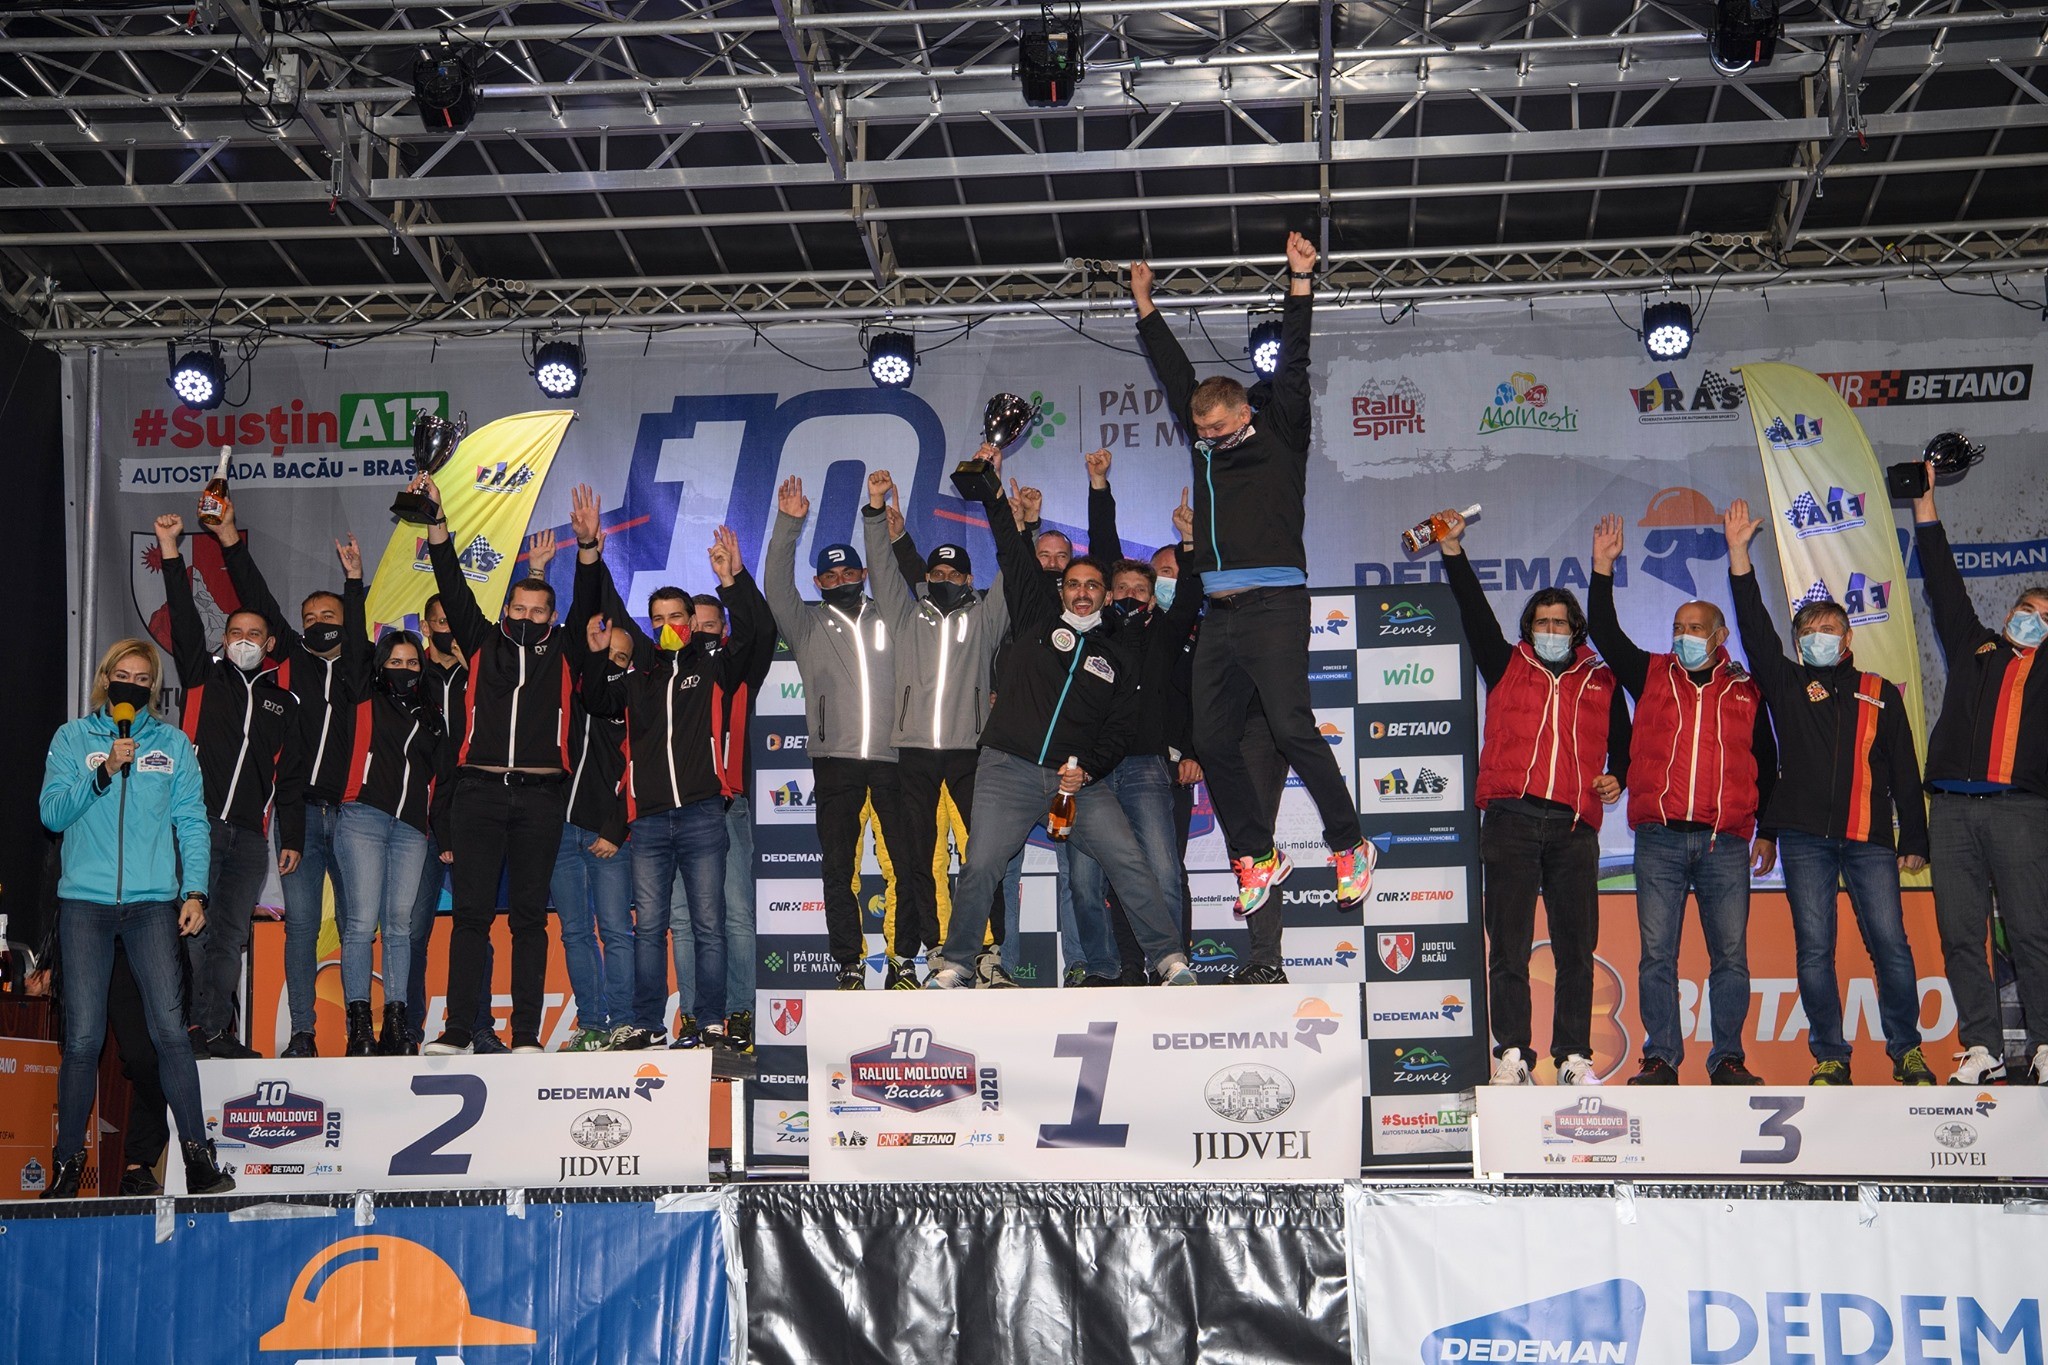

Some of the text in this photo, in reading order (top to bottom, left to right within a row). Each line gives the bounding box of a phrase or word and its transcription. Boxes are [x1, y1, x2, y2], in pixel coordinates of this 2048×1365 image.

[1906, 371, 2025, 400] BETANO
[1352, 394, 1416, 418] Rally
[1639, 385, 1740, 413] FRAS
[1100, 422, 1140, 448] DE
[1352, 414, 1426, 441] Spirit
[132, 463, 266, 484] AUTOSTADA
[273, 457, 343, 479] BACĂU
[1383, 663, 1434, 686] wilo
[1387, 721, 1452, 737] BETANO
[1379, 779, 1444, 795] FRAS
[1376, 890, 1454, 903] CNR BETANO
[769, 902, 791, 911] CNR
[1421, 941, 1456, 953] JUDEȚUL
[1421, 951, 1447, 963] BACĂU
[793, 963, 808, 973] DE
[1373, 1011, 1439, 1022] DEDEMAN
[890, 1030, 932, 1060] 10
[1153, 1031, 1288, 1051] DEDEMAN
[859, 1066, 967, 1081] RALIUL MOLDOVEI
[1393, 1070, 1451, 1086] Zemeș
[255, 1082, 289, 1106] 10
[537, 1087, 630, 1101] DEDEMAN
[885, 1082, 944, 1100] Bacău
[980, 1067, 999, 1111] 2020
[1036, 1021, 1129, 1149] 1
[1578, 1097, 1601, 1115] 10
[1909, 1107, 1973, 1115] DEDEMAN
[230, 1110, 317, 1123] RALIUL MOLDOVEI
[388, 1074, 488, 1176] 2
[1560, 1117, 1623, 1126] RALIUL MOLDOVEI
[248, 1124, 297, 1139] Bacău
[325, 1111, 341, 1148] 2020
[1420, 1127, 1440, 1135] BACĂU
[1629, 1118, 1641, 1145] 2020
[1740, 1096, 1805, 1164] 3
[879, 1134, 954, 1146] CNR BETANO
[1193, 1130, 1312, 1169] JIDVEI
[1592, 1155, 1616, 1163] BETANO
[1930, 1152, 1987, 1170] JIDVEI
[246, 1164, 304, 1175] CNR BETANO
[559, 1155, 641, 1183] JIDVEI
[1440, 1337, 1628, 1364] DEDEMAN
